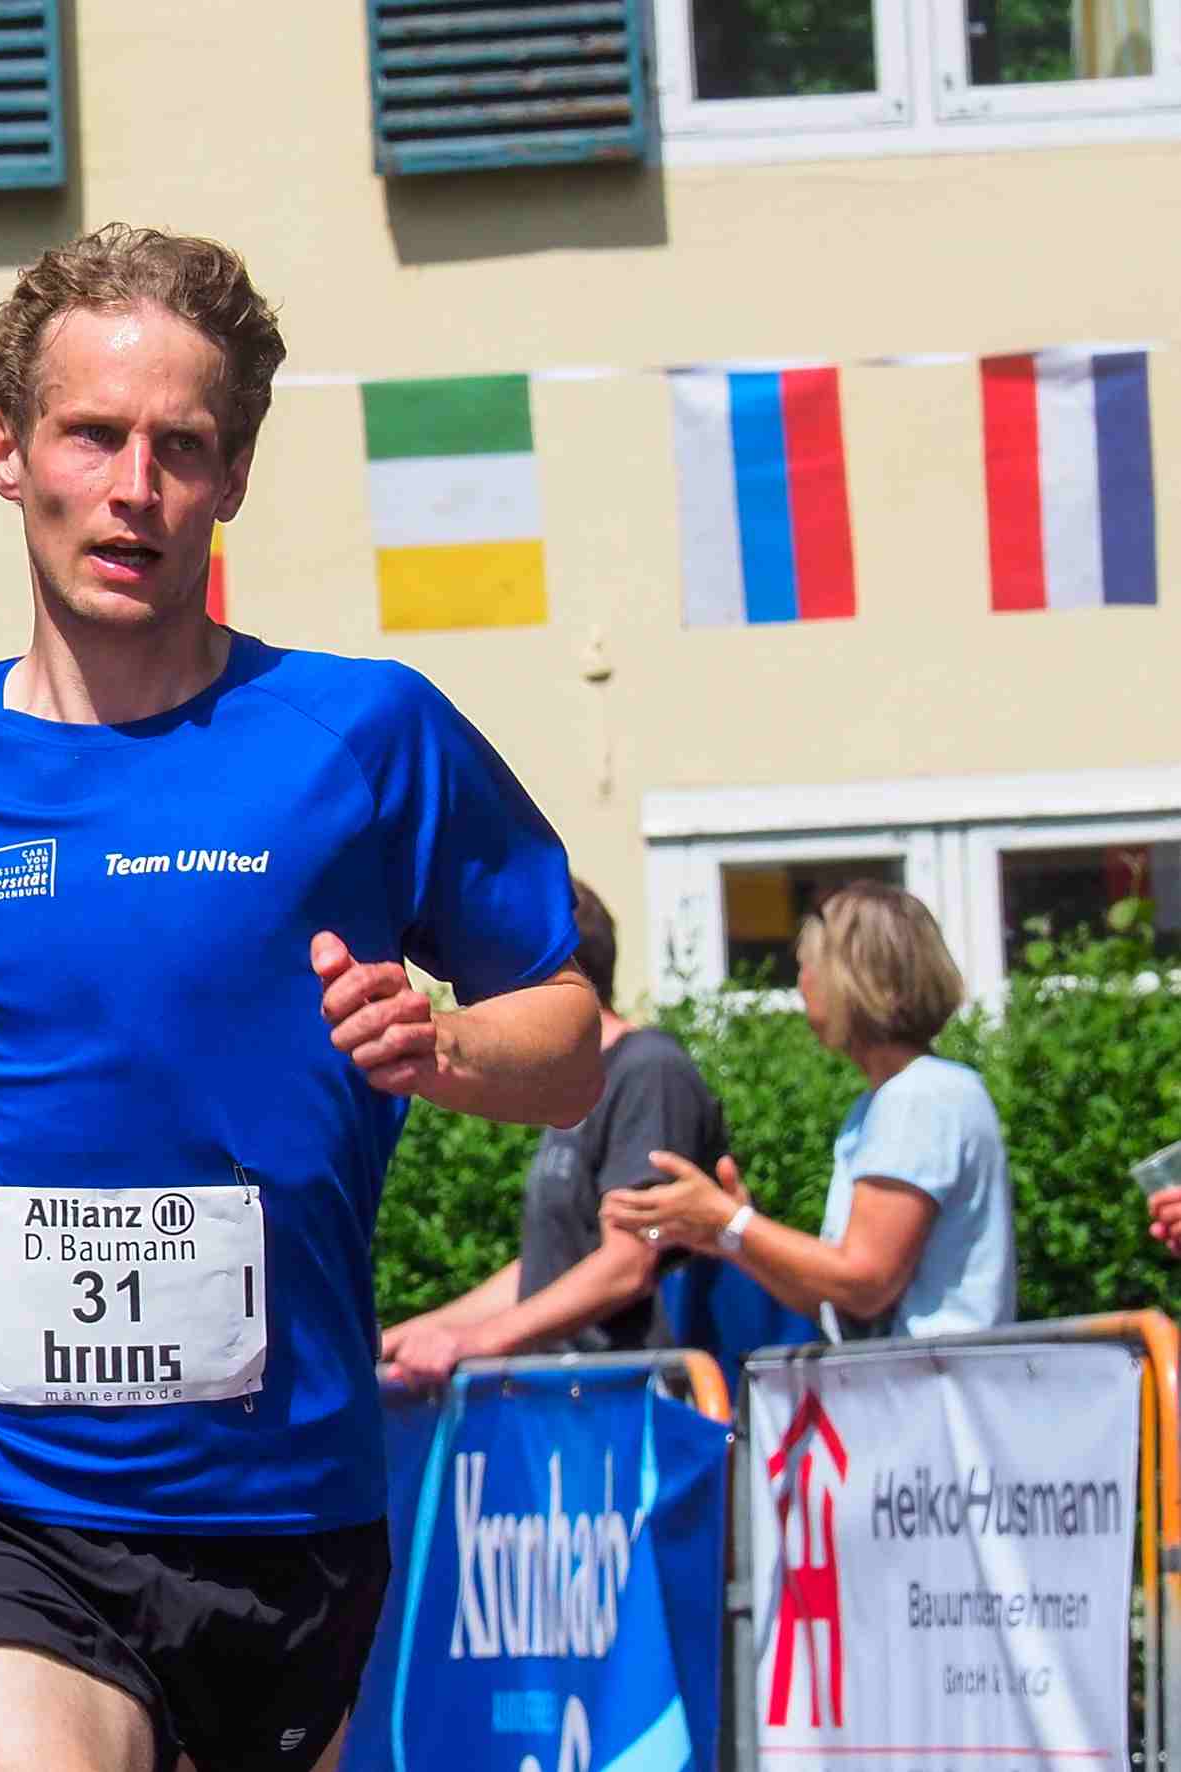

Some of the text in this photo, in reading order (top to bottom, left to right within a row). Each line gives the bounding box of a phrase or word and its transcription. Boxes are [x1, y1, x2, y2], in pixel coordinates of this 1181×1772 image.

[21, 847, 49, 858] CARL
[26, 855, 49, 865] VON
[105, 850, 270, 876] Team UNIted
[24, 1198, 142, 1228] Allianz
[25, 1233, 196, 1262] D. Baumann
[72, 1270, 141, 1323] 31
[44, 1330, 181, 1383] bruns
[871, 1466, 1121, 1538] Heiko Husmann
